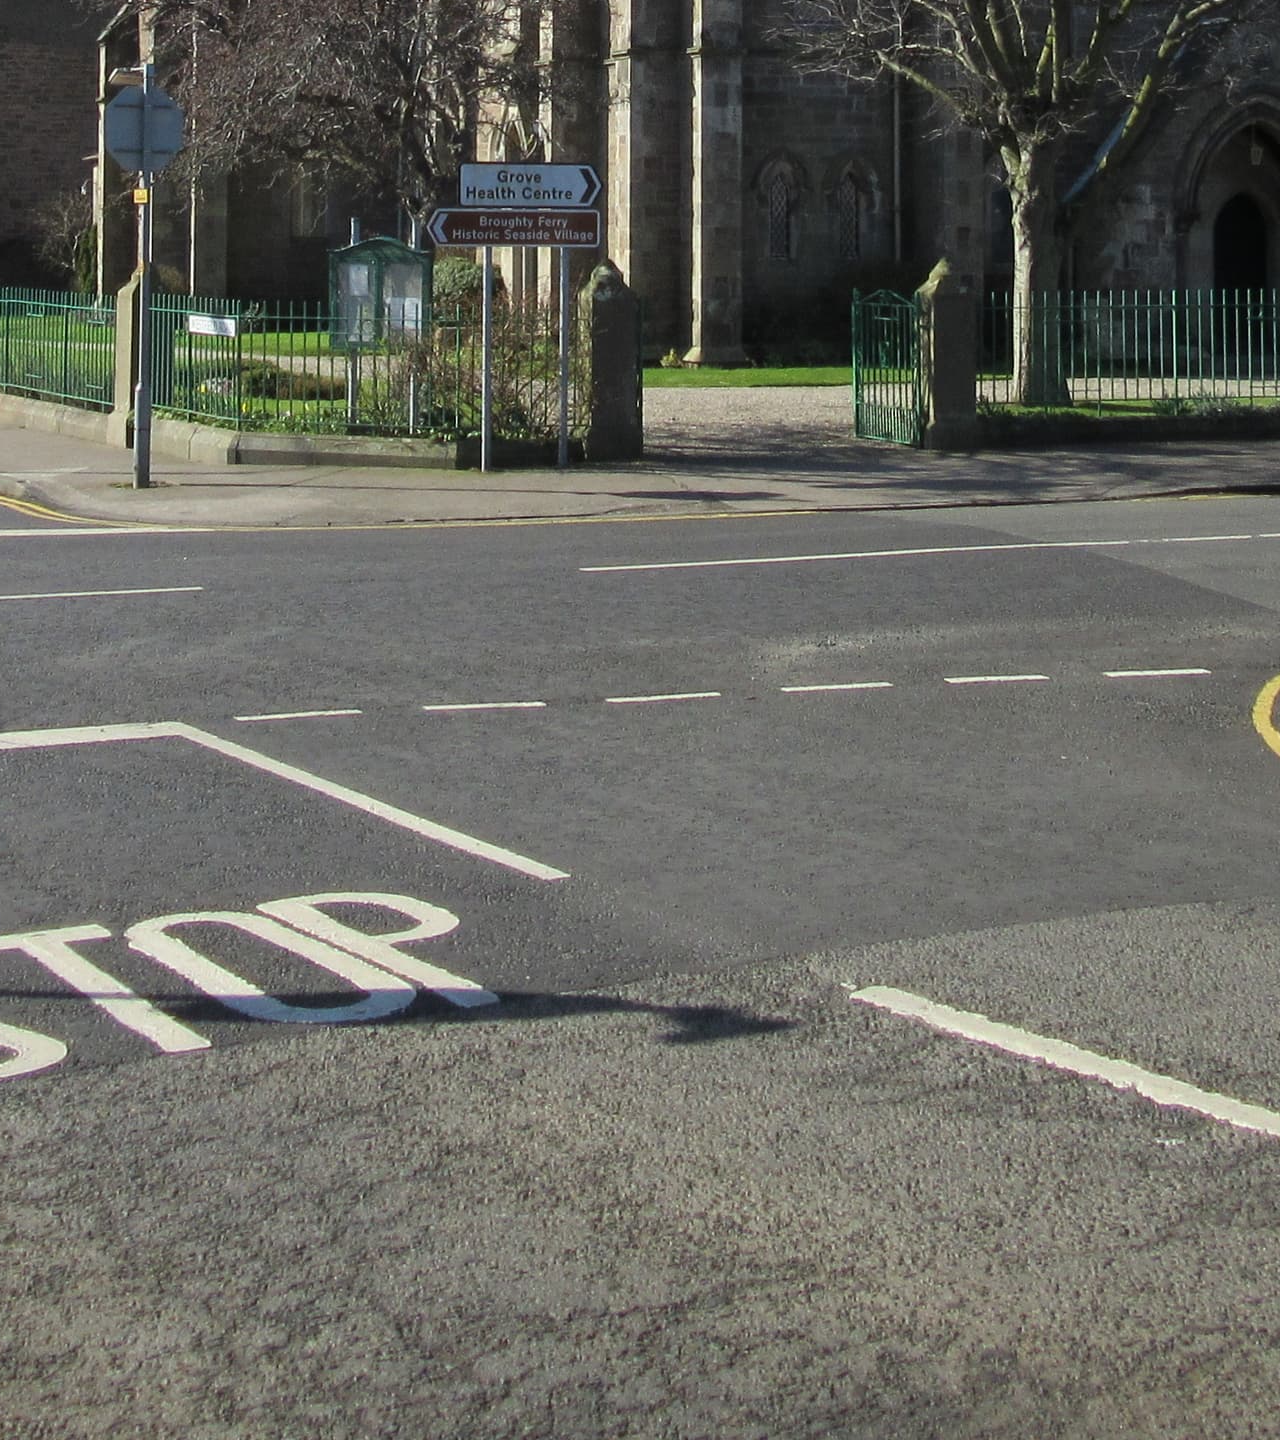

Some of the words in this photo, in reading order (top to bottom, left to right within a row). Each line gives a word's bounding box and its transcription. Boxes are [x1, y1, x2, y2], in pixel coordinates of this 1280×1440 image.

[497, 170, 542, 184] Grove
[466, 187, 516, 200] Health
[522, 187, 573, 200] Centre
[479, 215, 533, 229] Broughty
[538, 215, 568, 229] Ferry
[452, 229, 499, 240] Historic
[504, 229, 550, 240] Seaside
[554, 229, 594, 242] Village
